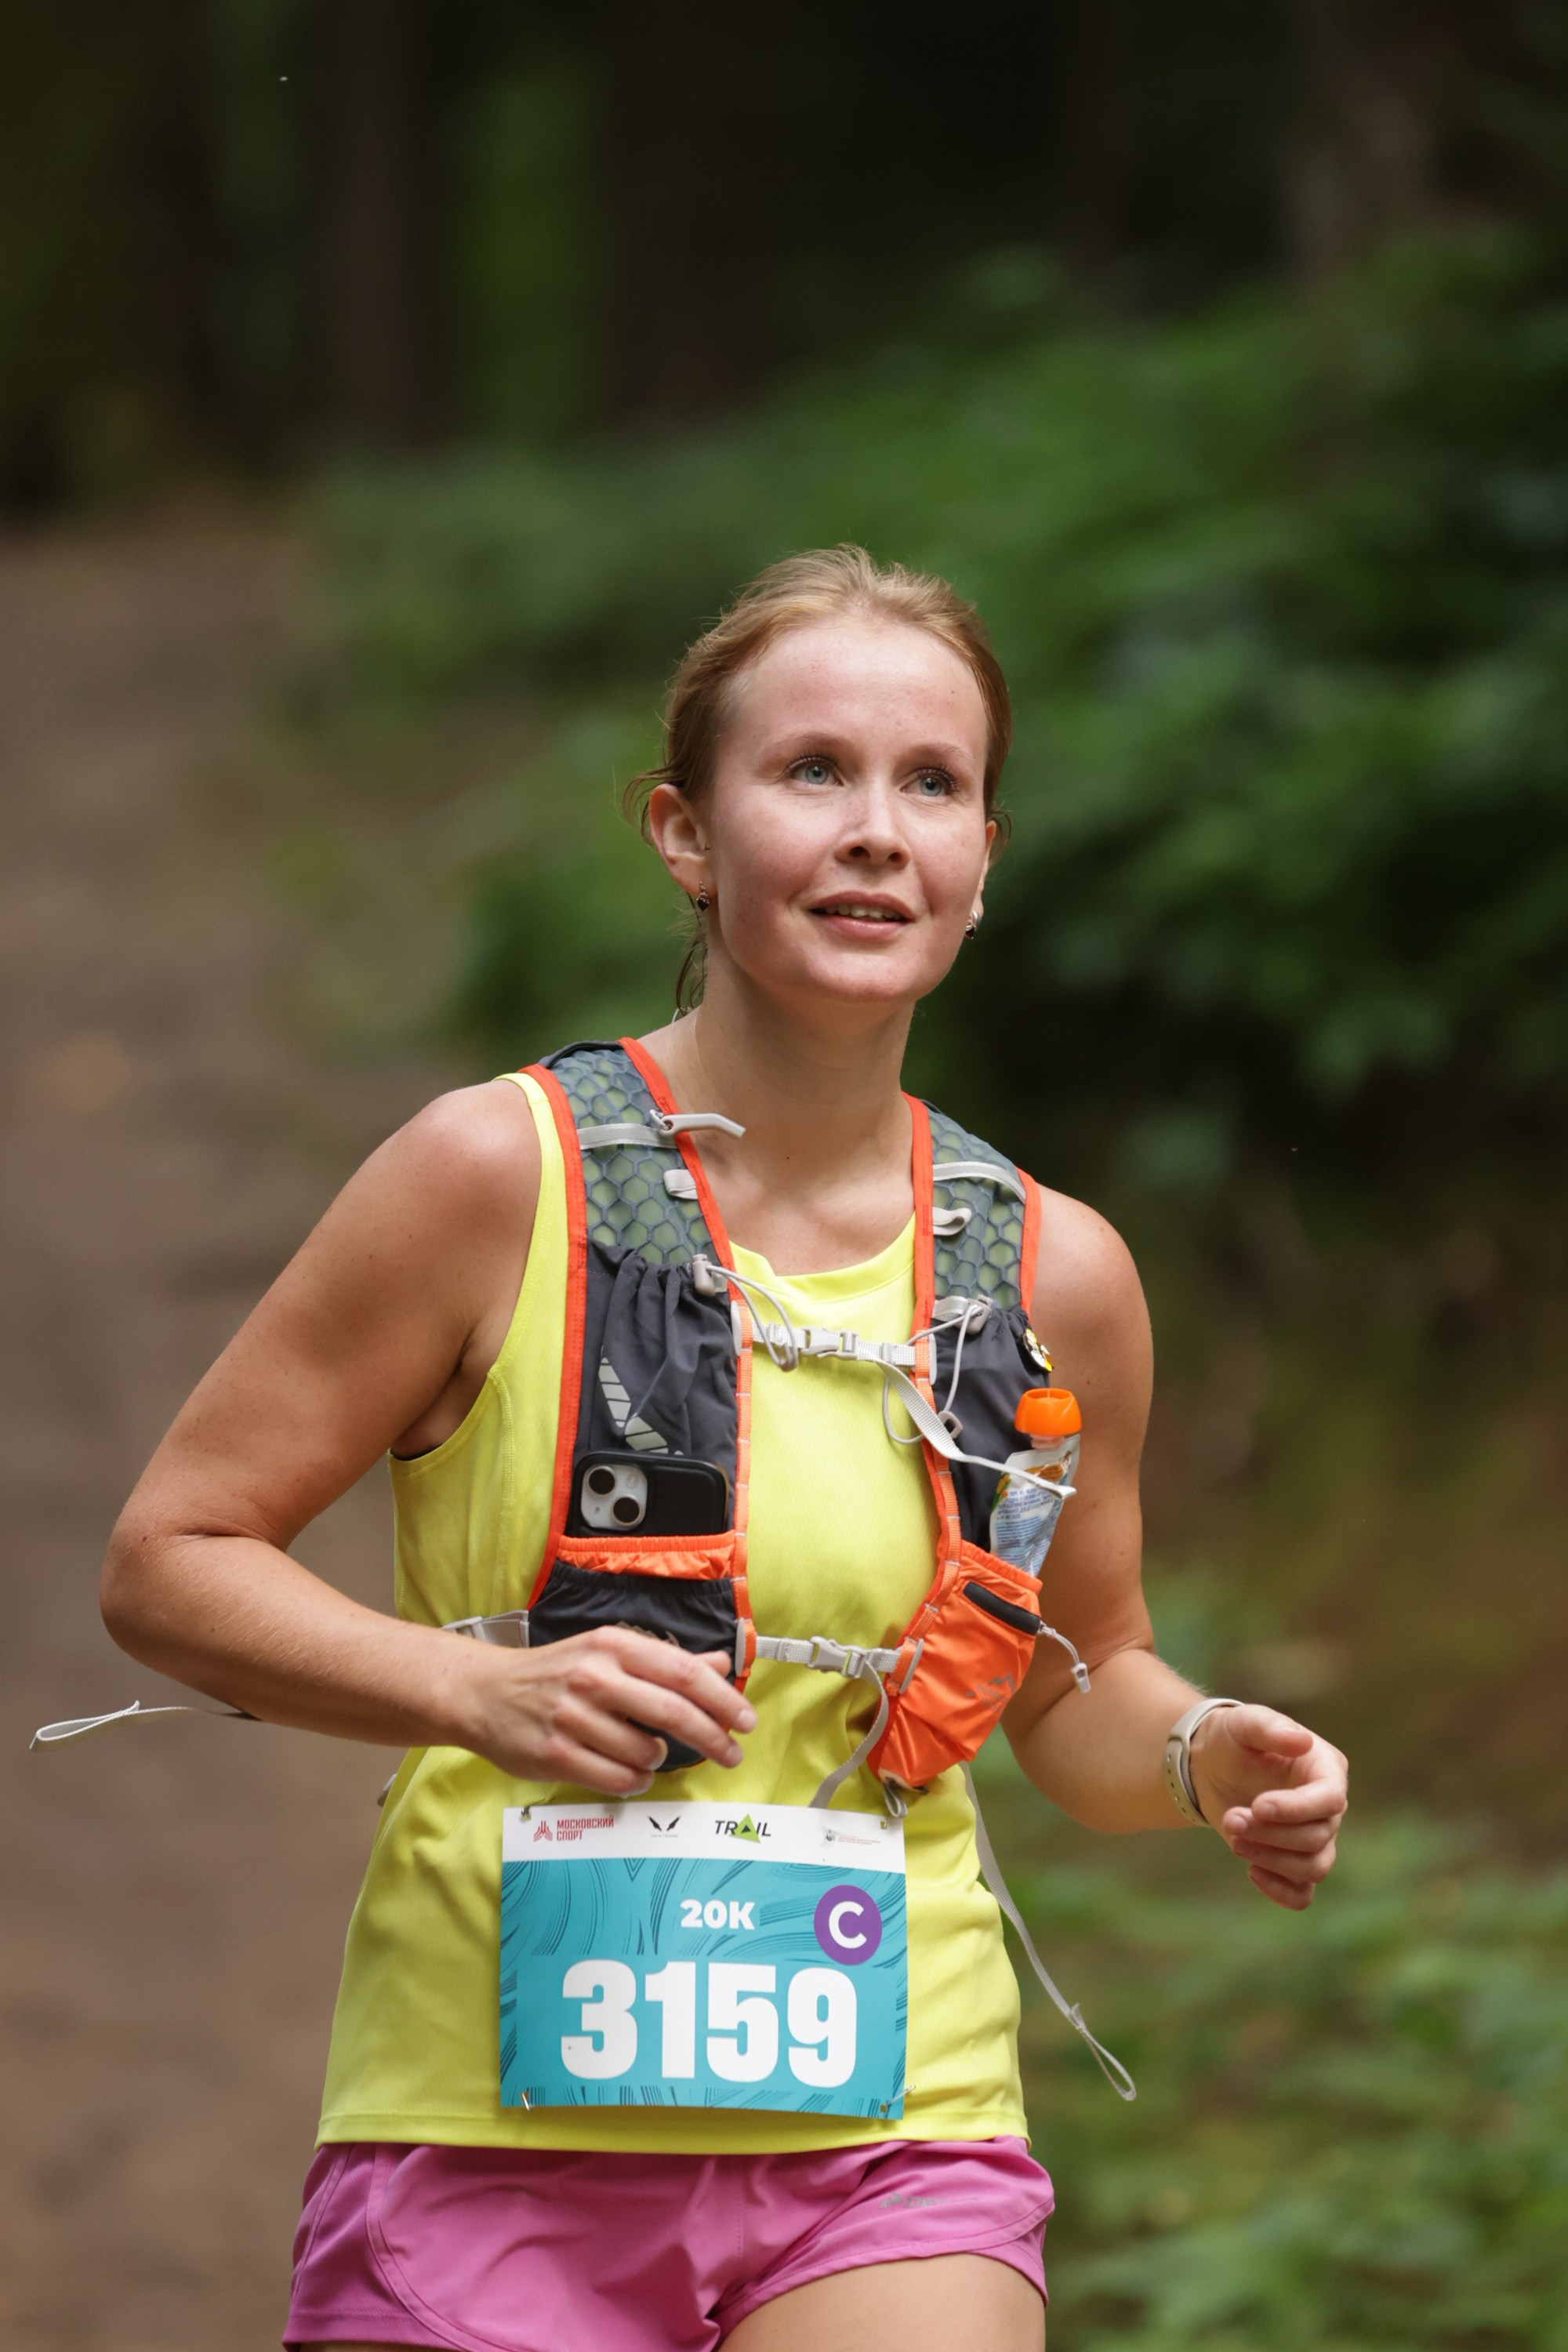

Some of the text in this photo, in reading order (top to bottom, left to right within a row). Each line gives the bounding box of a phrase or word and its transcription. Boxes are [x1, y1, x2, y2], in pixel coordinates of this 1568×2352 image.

[556, 1816, 615, 1829] МОСКОВСКИЙ
[556, 1830, 583, 1842] СПОРТ
[680, 1899, 755, 1930] 20K
[561, 1958, 857, 2088] 3159
